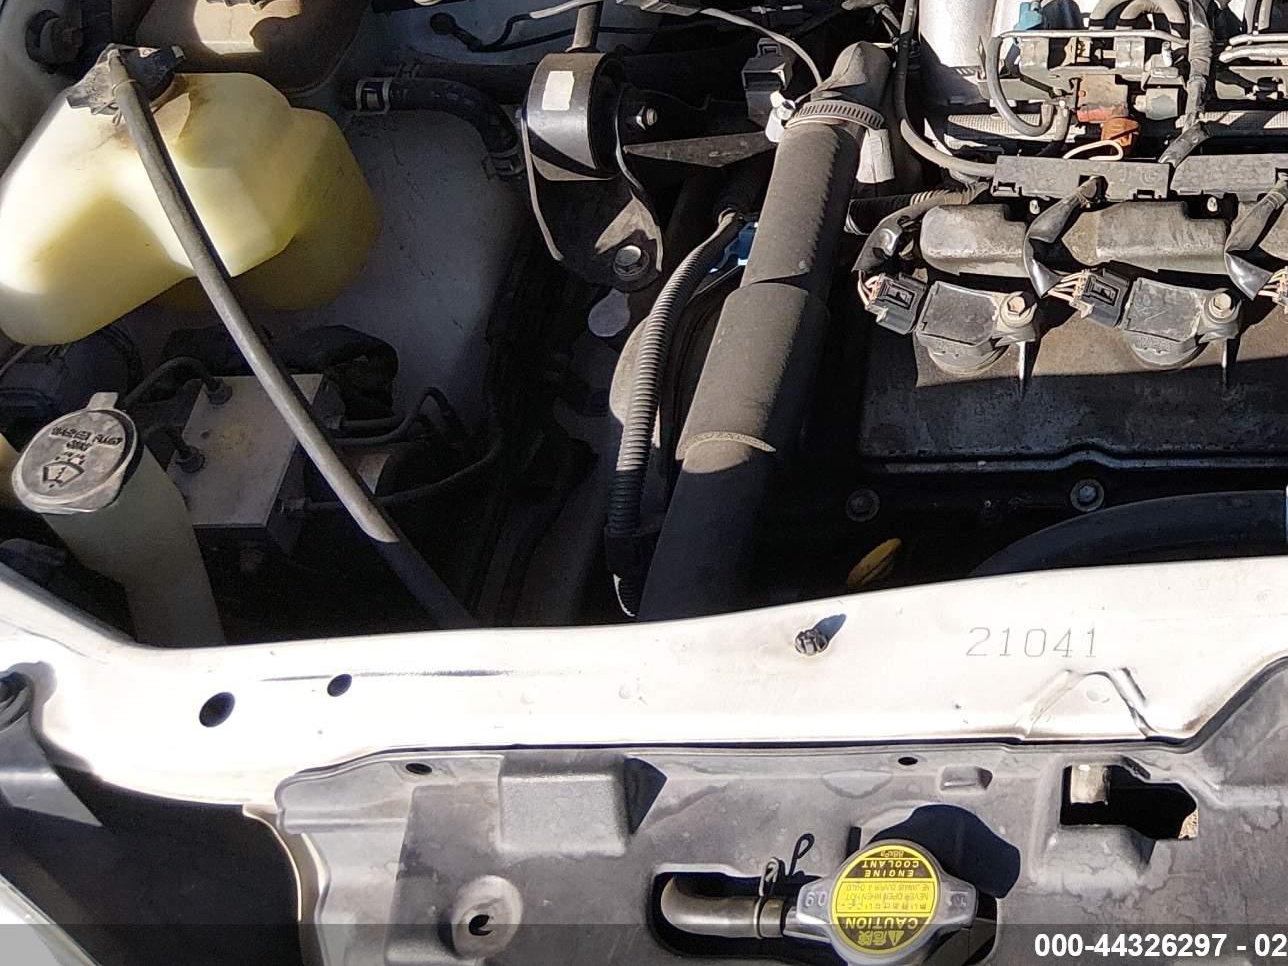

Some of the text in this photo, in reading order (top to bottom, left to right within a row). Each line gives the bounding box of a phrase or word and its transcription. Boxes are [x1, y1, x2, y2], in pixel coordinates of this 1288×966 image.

[965, 626, 1097, 658] 21041
[862, 860, 920, 868] COOLANT
[864, 869, 914, 877] ENGINE
[845, 917, 919, 929] CAUTION
[858, 930, 888, 946] 危険
